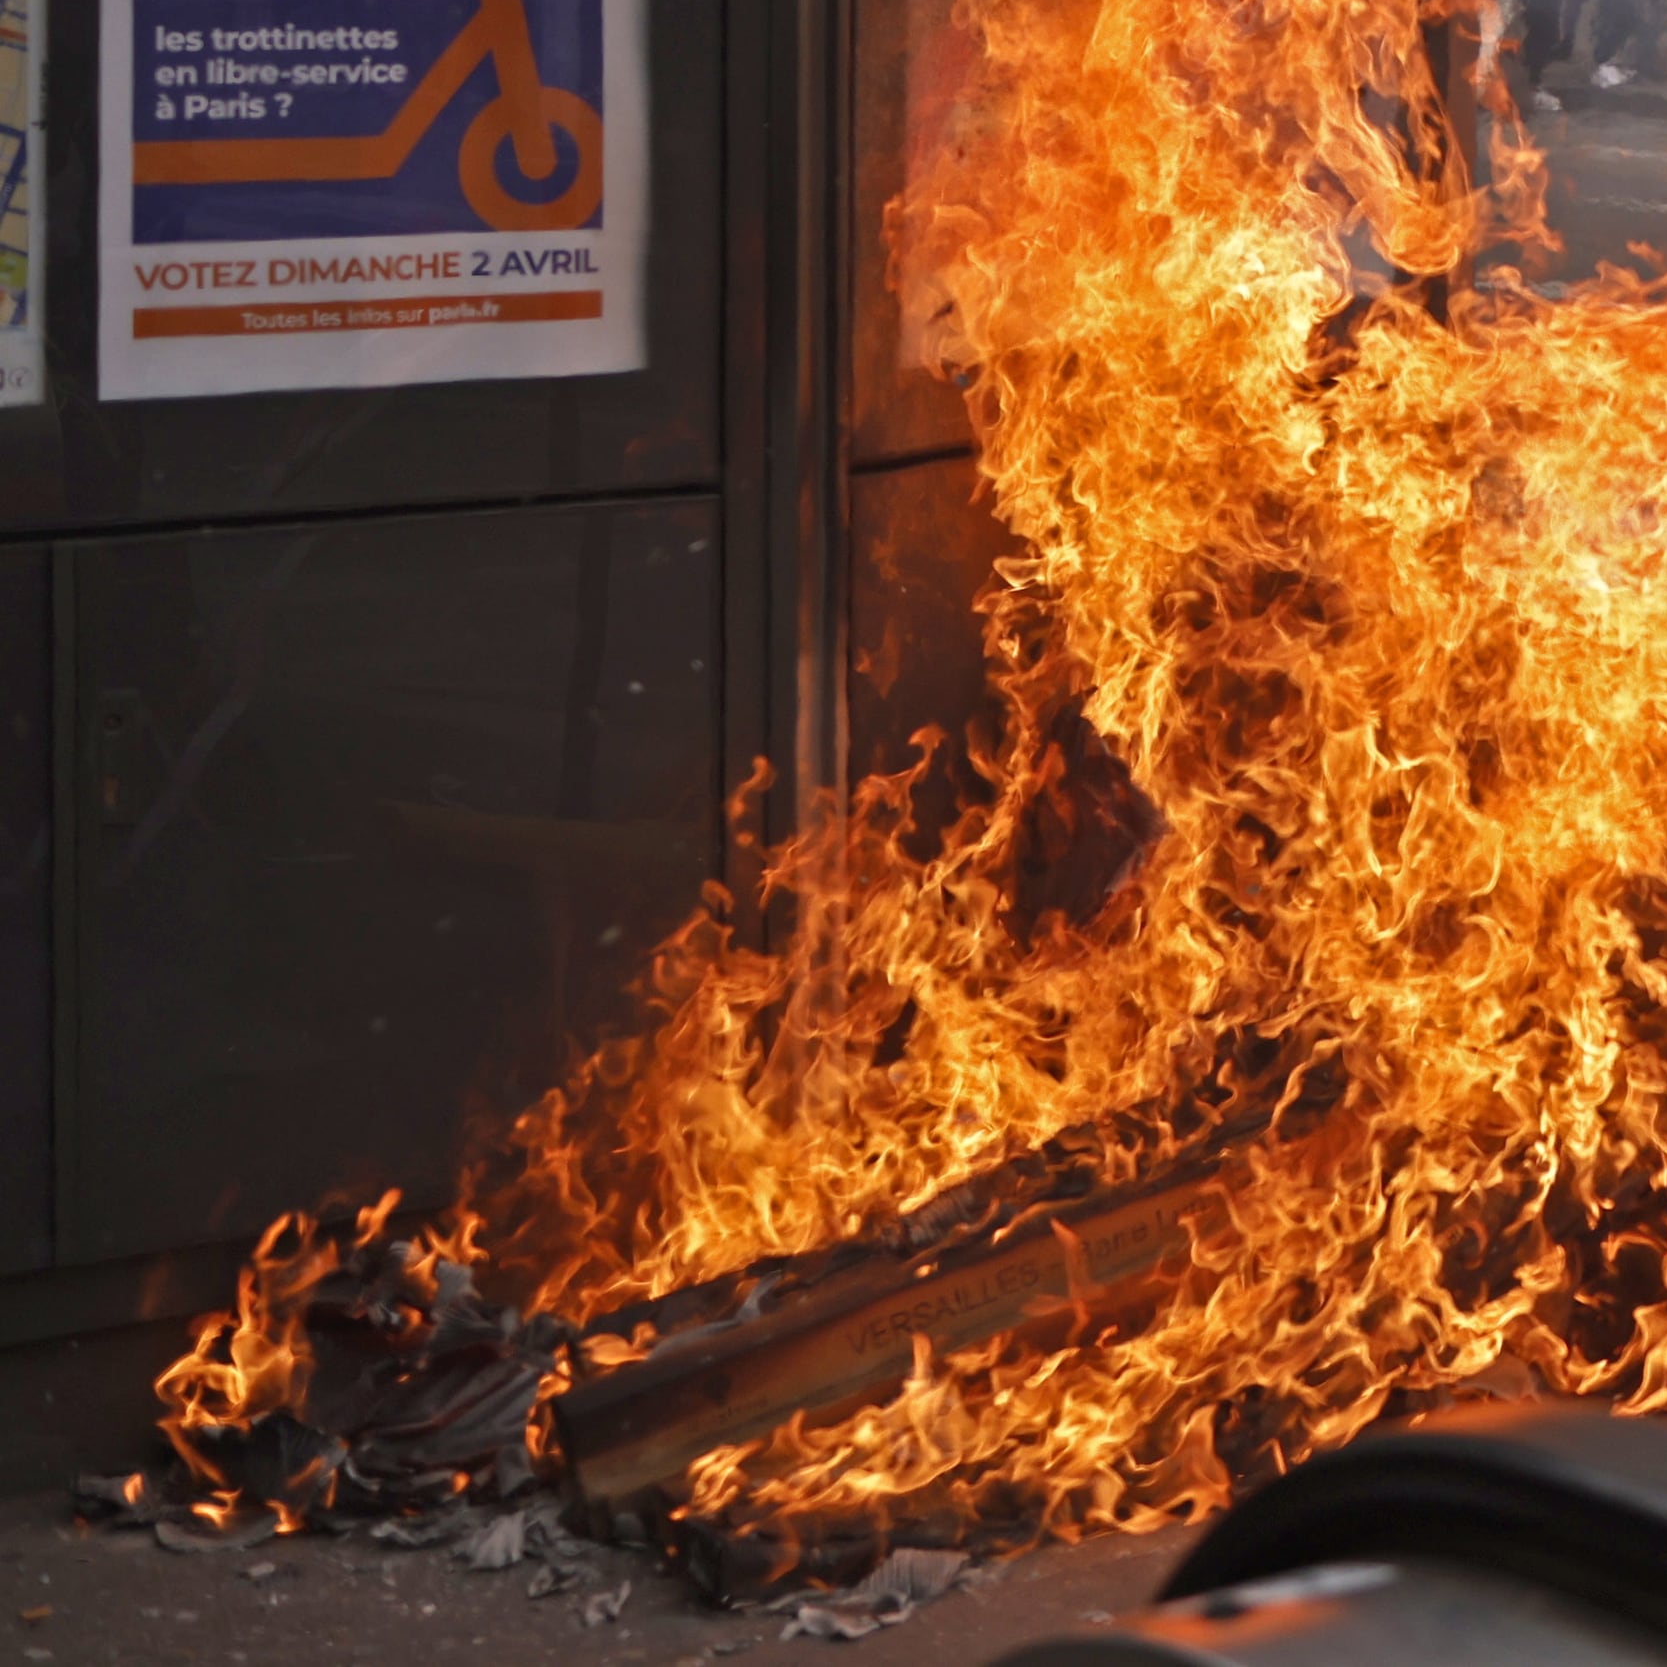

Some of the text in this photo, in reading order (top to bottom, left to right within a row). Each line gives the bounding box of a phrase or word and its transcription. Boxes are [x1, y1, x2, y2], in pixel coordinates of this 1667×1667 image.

[155, 23, 398, 52] les trottinettes
[155, 56, 408, 86] en libre-service
[155, 91, 293, 120] à Paris ?
[134, 248, 599, 291] VOTEZ DIMANCHE 2 AVRIL
[242, 311, 307, 332] Toutes
[312, 307, 342, 328] les
[347, 304, 392, 326] infos
[396, 306, 424, 324] sur
[847, 1262, 1040, 1357] VERSAILLES
